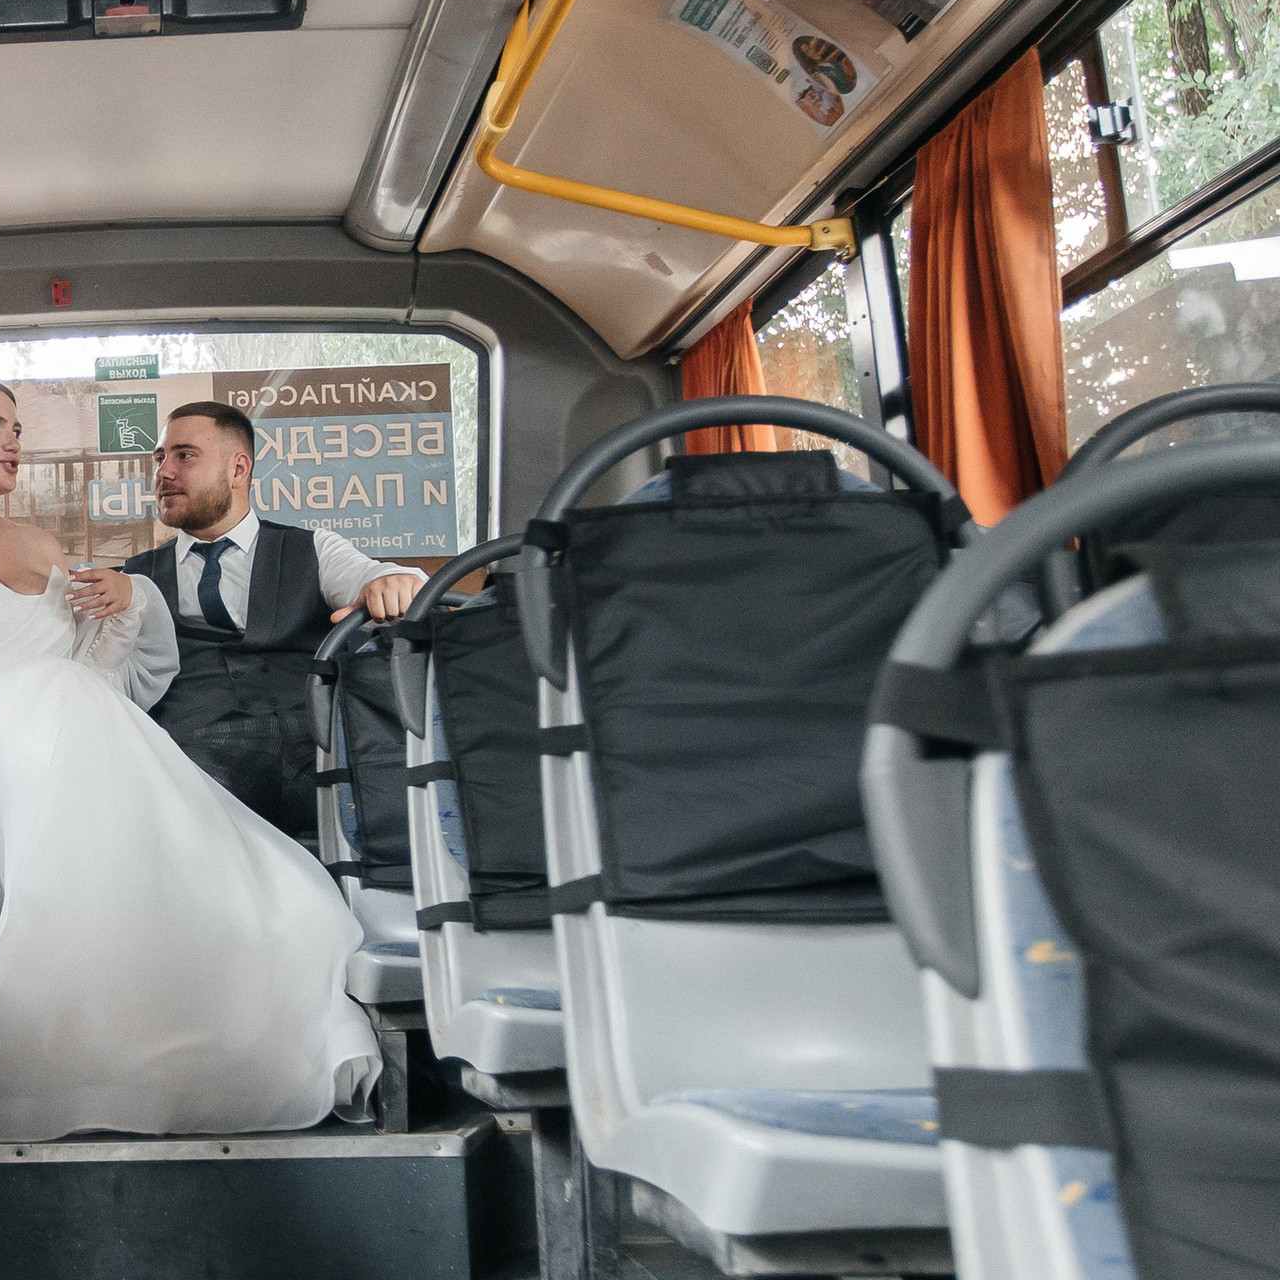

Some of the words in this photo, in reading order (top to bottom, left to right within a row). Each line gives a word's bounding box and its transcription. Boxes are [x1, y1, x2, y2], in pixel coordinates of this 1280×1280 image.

[99, 354, 156, 367] ЗАПАСНЫЙ
[109, 368, 147, 379] ВЫХОД
[100, 397, 132, 406] Запасный
[133, 397, 155, 405] выход
